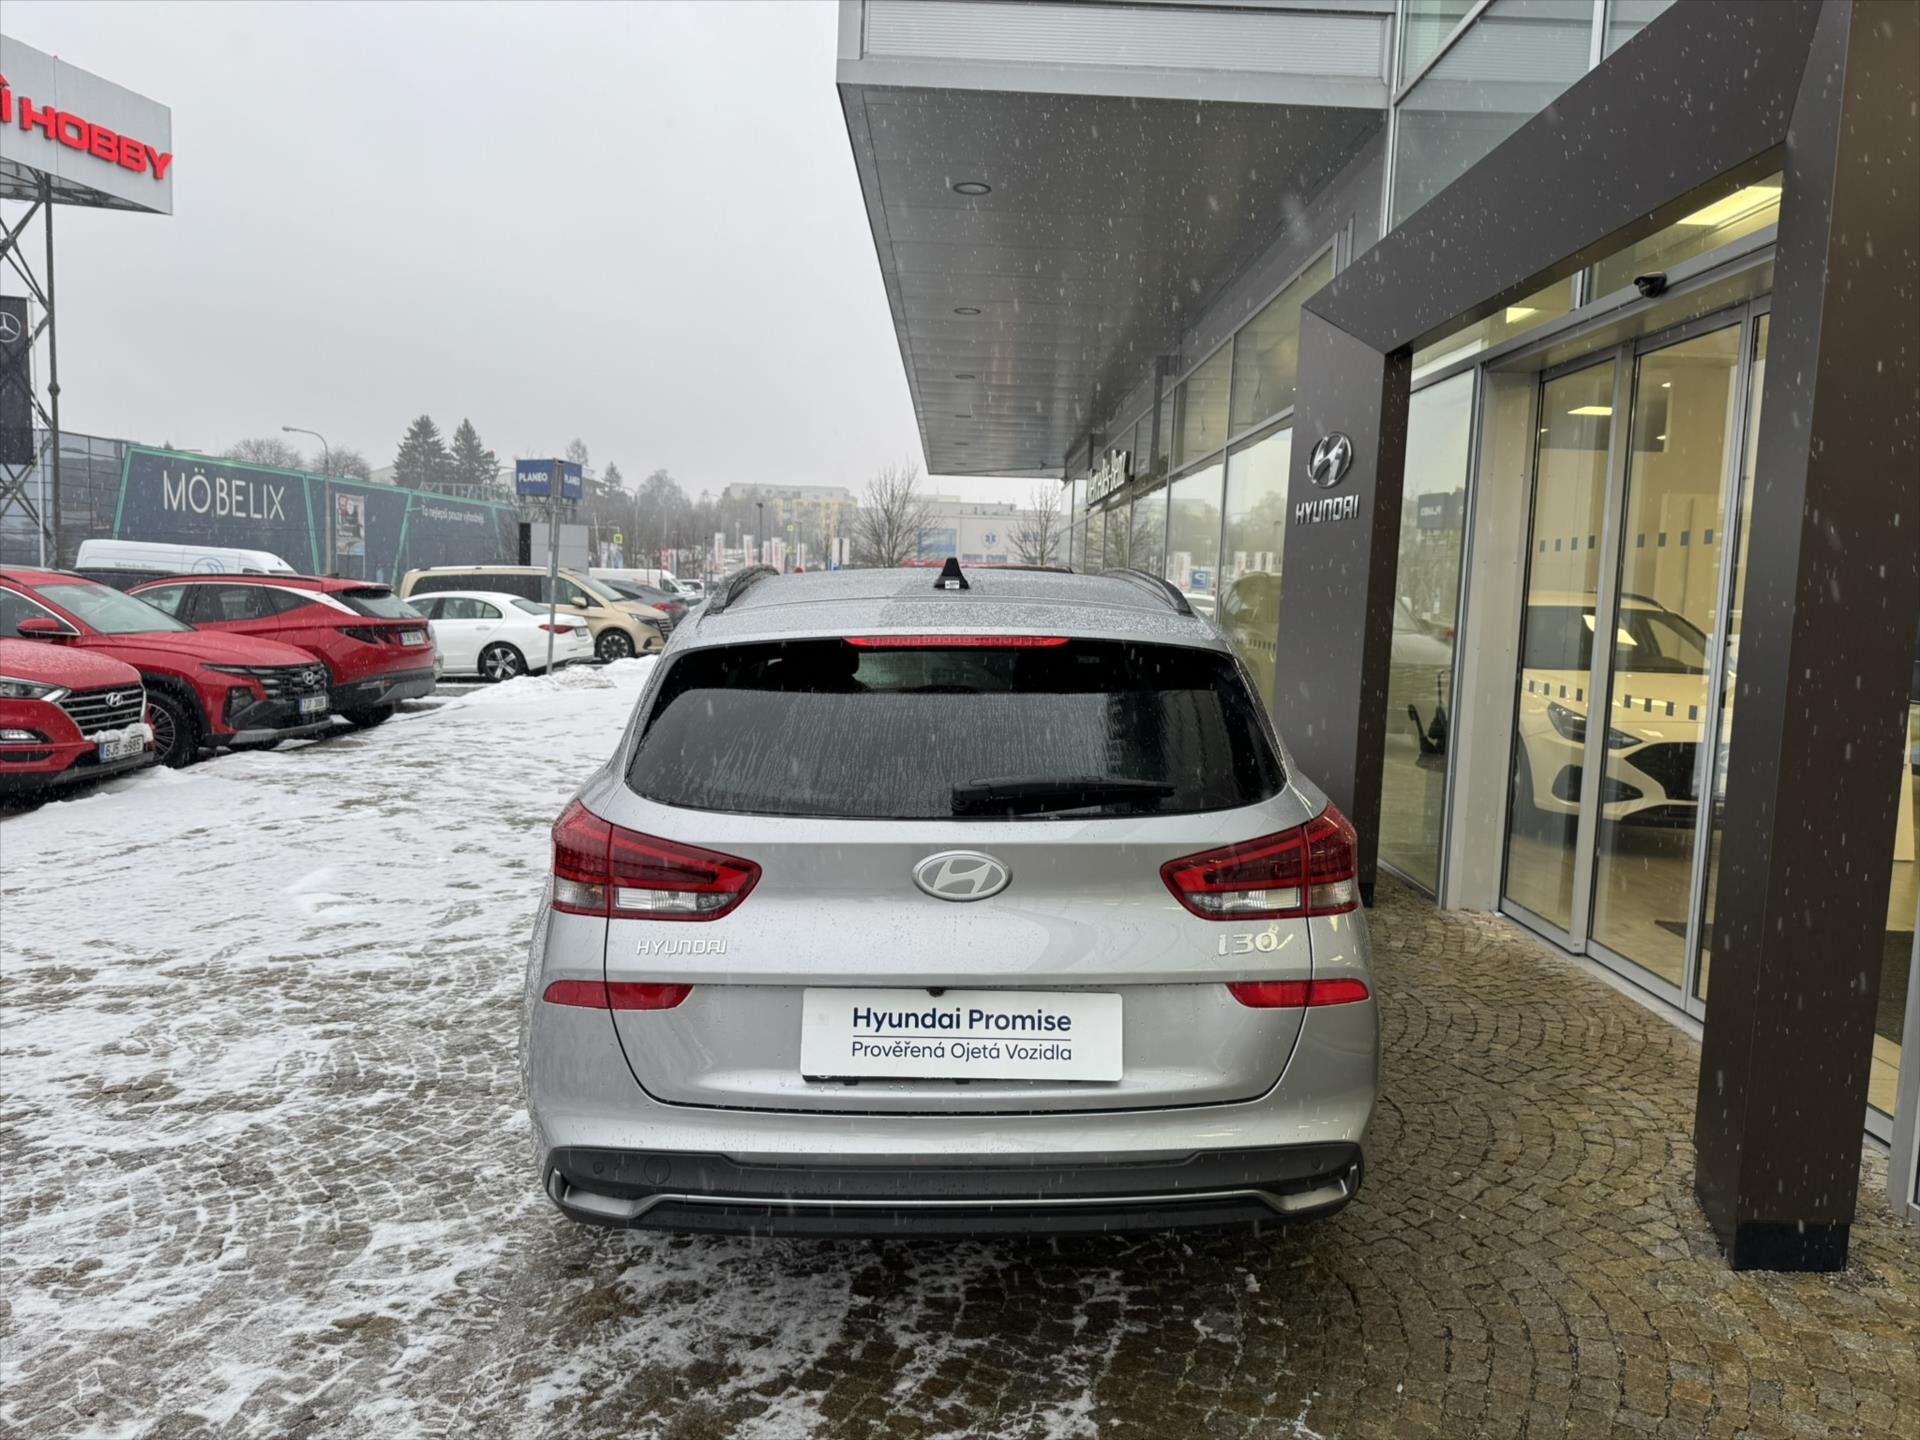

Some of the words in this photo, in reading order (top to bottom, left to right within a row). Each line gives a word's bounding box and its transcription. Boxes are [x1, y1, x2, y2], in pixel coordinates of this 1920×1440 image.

[18, 96, 172, 180] HOBBY
[518, 472, 548, 482] PLANEO
[163, 467, 285, 521] MÖBELIX
[1295, 494, 1359, 525] HYUNDAI
[636, 940, 727, 955] HYUNDAI
[852, 1007, 960, 1033] Hyundai
[968, 1009, 1071, 1031] Promise
[852, 1041, 945, 1059] Prověřená
[951, 1042, 1000, 1062] Ojetá
[1005, 1043, 1072, 1061] Vozidla
